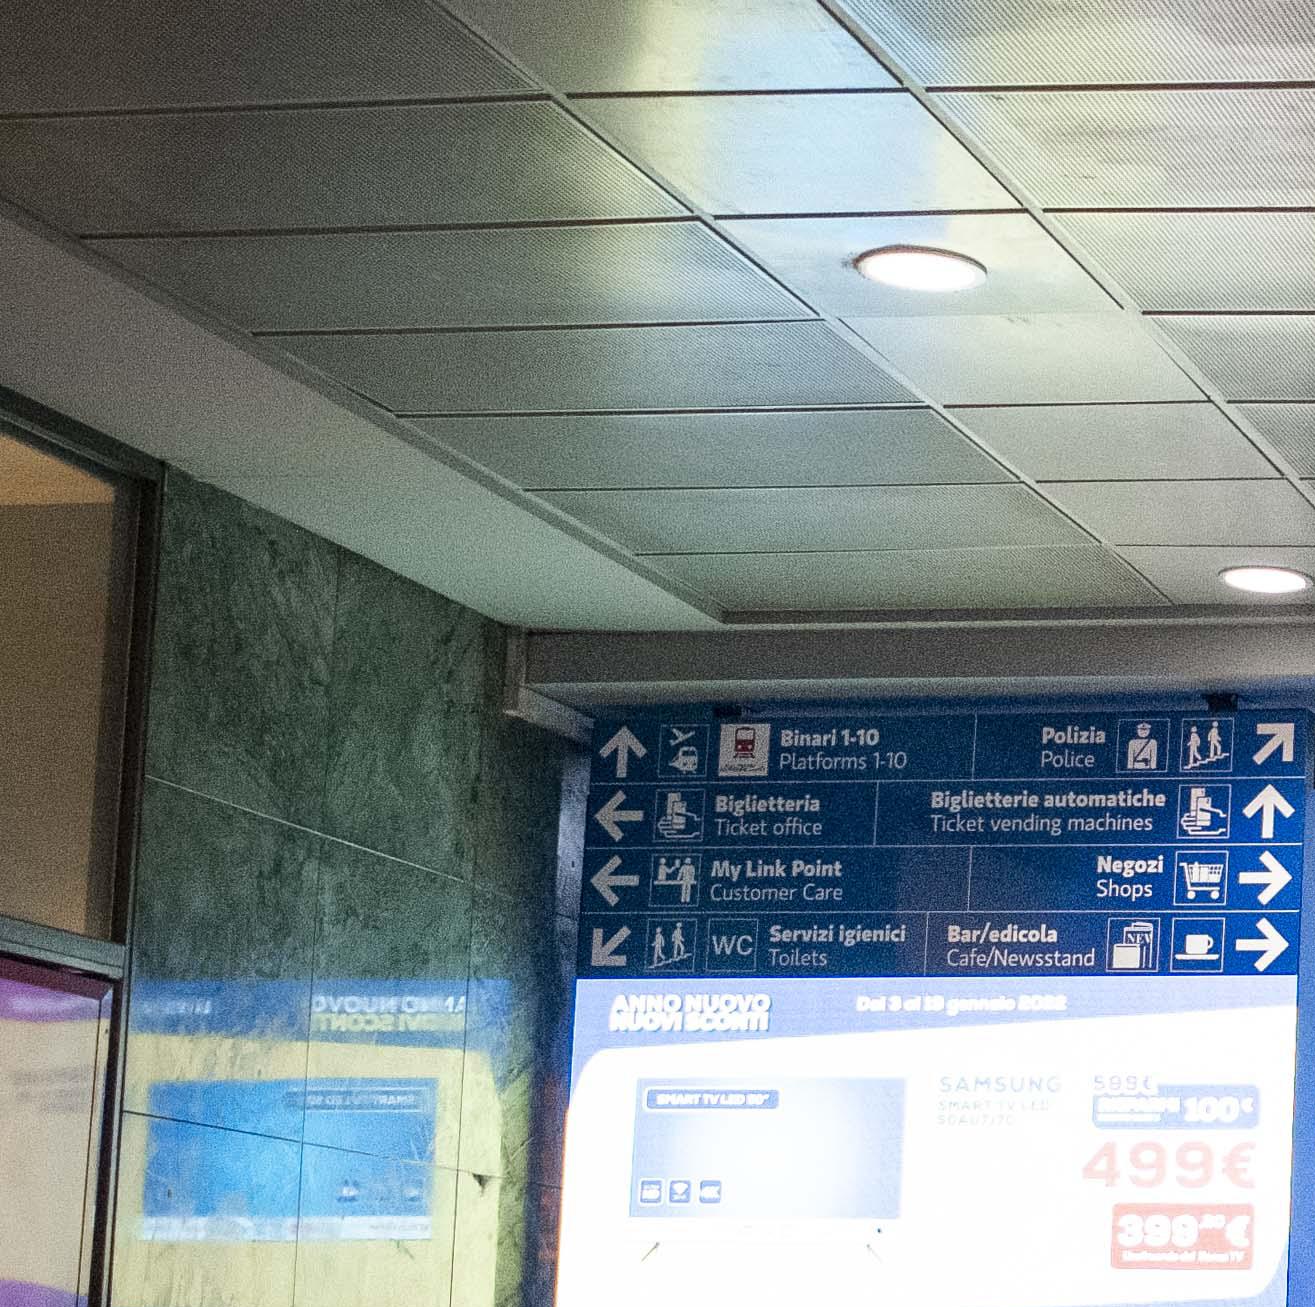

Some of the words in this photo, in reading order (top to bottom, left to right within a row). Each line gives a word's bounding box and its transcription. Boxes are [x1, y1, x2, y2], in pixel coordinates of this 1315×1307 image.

[780, 729, 836, 747] Binari
[841, 728, 880, 746] 1-10
[1042, 727, 1105, 744] Polizia
[780, 753, 866, 770] Platforms
[874, 752, 907, 769] 1-10
[1041, 750, 1094, 768] Police
[715, 795, 820, 816] Biglietteria
[930, 791, 1039, 812] Biglietterie
[1044, 790, 1166, 807] automatiche
[715, 818, 767, 836] Ticket
[773, 817, 822, 836] office
[931, 815, 984, 832] Ticket
[991, 815, 1061, 835] vending
[1068, 814, 1153, 831] machines
[711, 860, 739, 882] My
[746, 860, 786, 877] Link
[792, 860, 842, 877] Point
[1097, 855, 1163, 877] Negozi
[710, 884, 796, 901] Customer
[803, 884, 843, 900] Care
[1097, 879, 1153, 901] Shops
[769, 925, 834, 943] Servizi
[839, 925, 906, 946] igienici
[948, 923, 1058, 944] Bar/edicola
[712, 936, 753, 956] WC
[769, 949, 827, 967] Toilets
[947, 946, 1095, 968] Cafe/Newsstand
[613, 993, 682, 1014] ANNO
[685, 992, 772, 1013] NUOVO
[609, 1012, 682, 1032] NUOVI
[684, 1011, 770, 1032] SCONTI
[938, 1075, 1063, 1093] SAMSUNG
[1081, 1140, 1257, 1189] 499€
